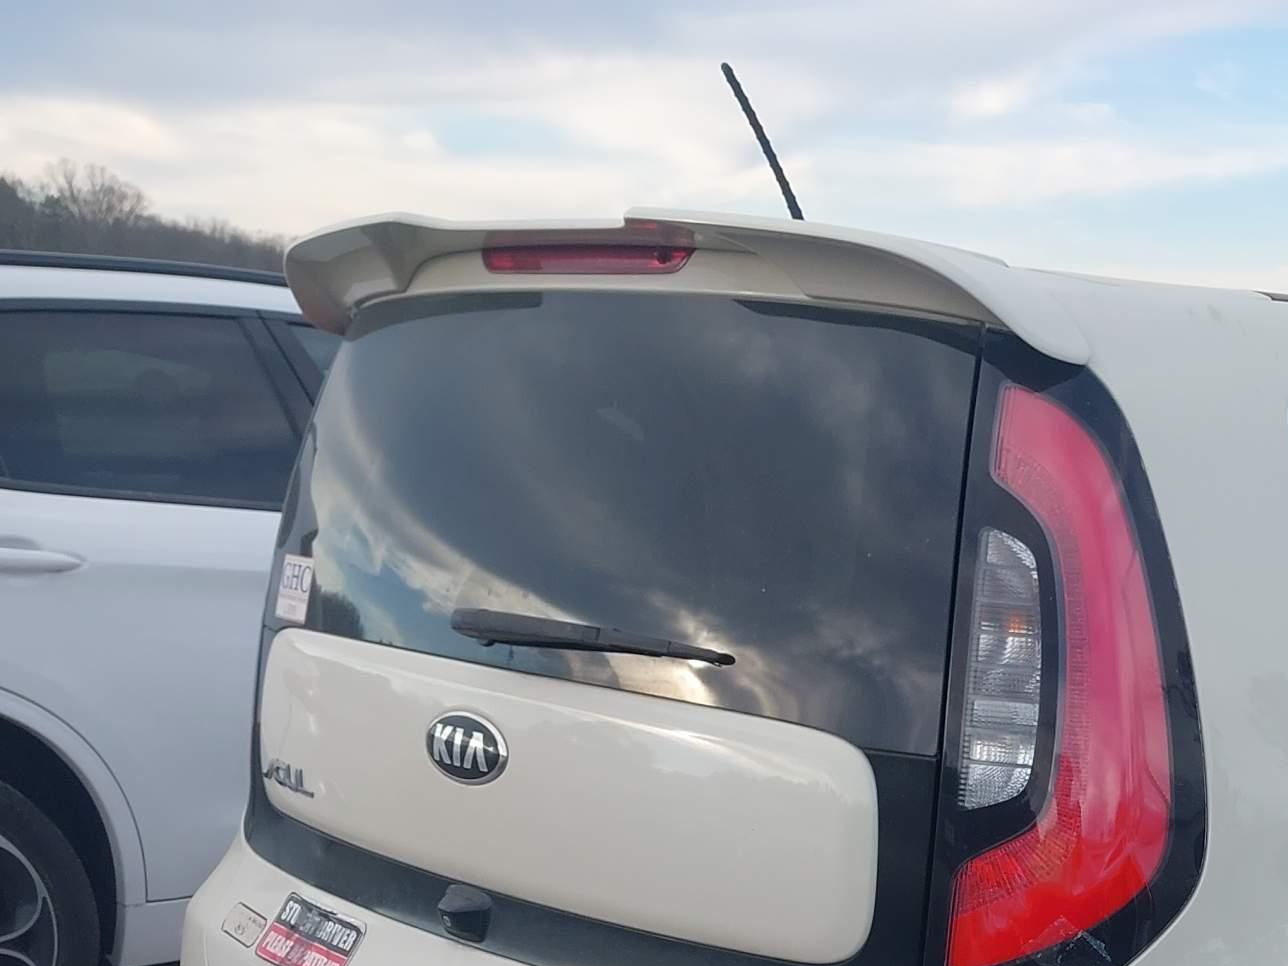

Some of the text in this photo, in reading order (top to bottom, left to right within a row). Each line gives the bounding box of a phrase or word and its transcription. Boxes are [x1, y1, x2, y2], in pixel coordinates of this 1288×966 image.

[282, 562, 311, 593] GHC
[433, 722, 489, 772] KIA
[262, 930, 294, 958] PLEASE
[315, 919, 357, 951] DRIVER
